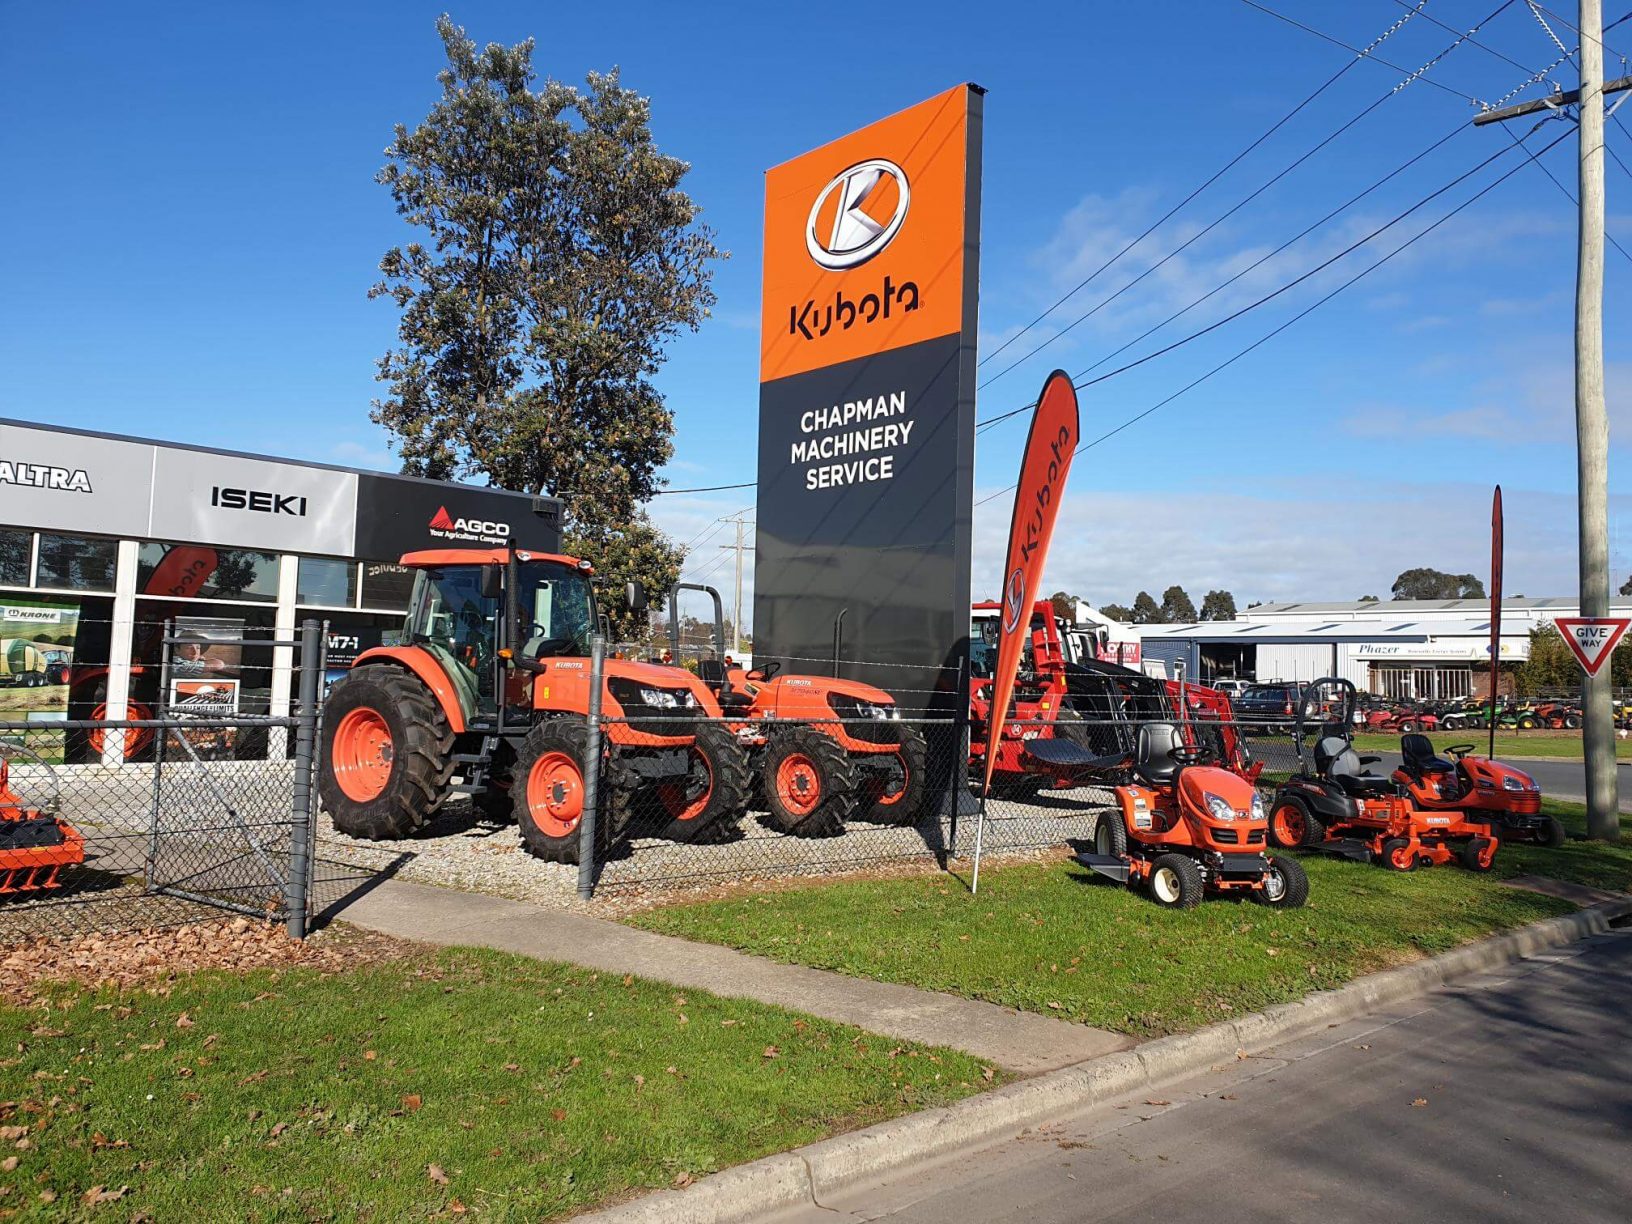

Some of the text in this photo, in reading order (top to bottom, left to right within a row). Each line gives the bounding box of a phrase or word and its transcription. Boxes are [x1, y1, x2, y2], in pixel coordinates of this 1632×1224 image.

[789, 276, 919, 341] Kubota
[801, 391, 905, 433] CHAPMAN
[791, 420, 914, 464] MACHINERY
[0, 460, 93, 493] ALTRA
[806, 455, 893, 490] SERVICE
[211, 486, 307, 517] ISEKI
[1021, 425, 1070, 562] Kubota
[430, 528, 508, 545] Your Agriculture Company
[454, 518, 510, 536] AGCO
[20, 611, 57, 619] KRONE
[1359, 643, 1400, 654] Phazer
[1576, 627, 1608, 638] GIVE
